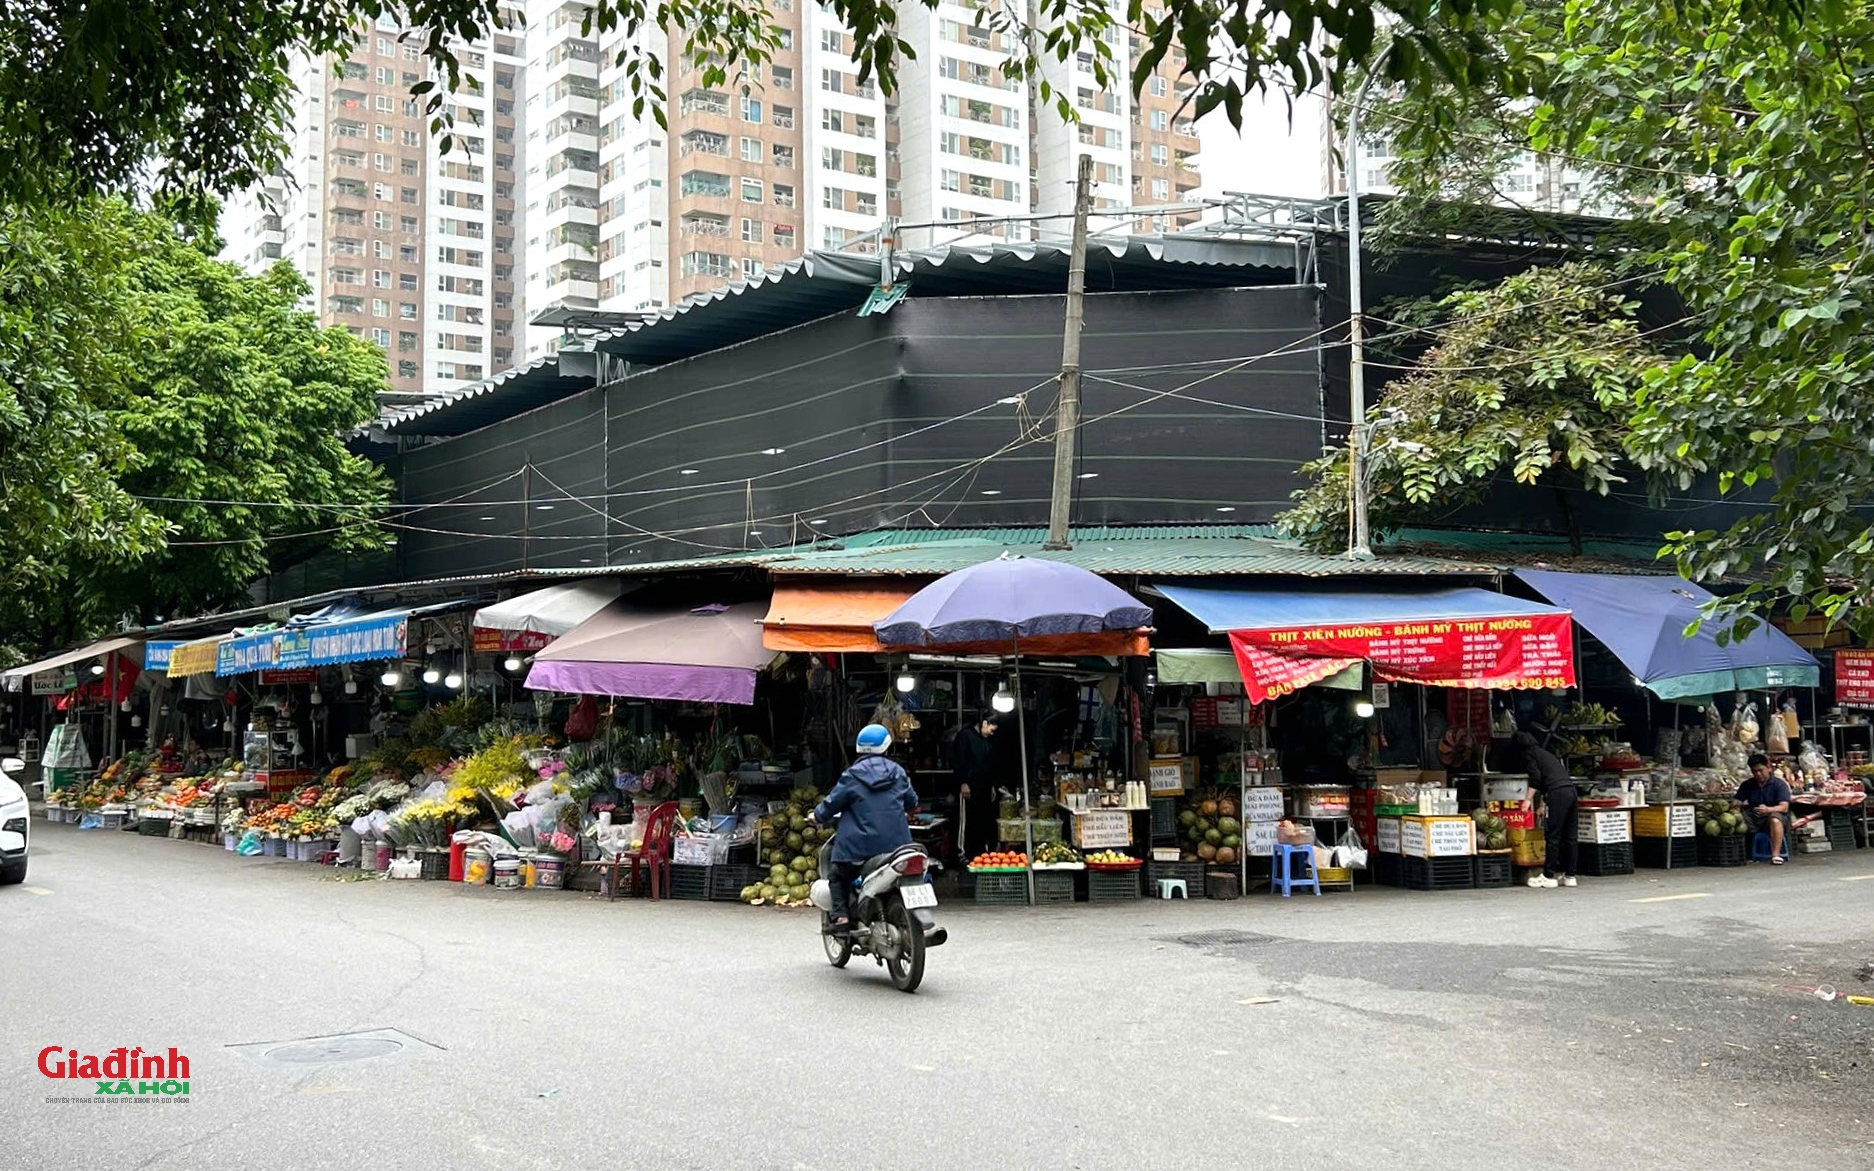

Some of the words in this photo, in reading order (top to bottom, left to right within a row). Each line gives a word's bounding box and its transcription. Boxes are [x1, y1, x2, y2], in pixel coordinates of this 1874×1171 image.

[1269, 631, 1299, 643] THỊT
[1303, 628, 1334, 641] XIÊN
[1338, 625, 1382, 639] NƯỚNG
[1394, 624, 1429, 636] BÁNH
[1458, 622, 1485, 634] THỊT
[1489, 619, 1532, 631] NƯỚNG
[1521, 677, 1543, 688] 690
[1546, 676, 1566, 687] 845
